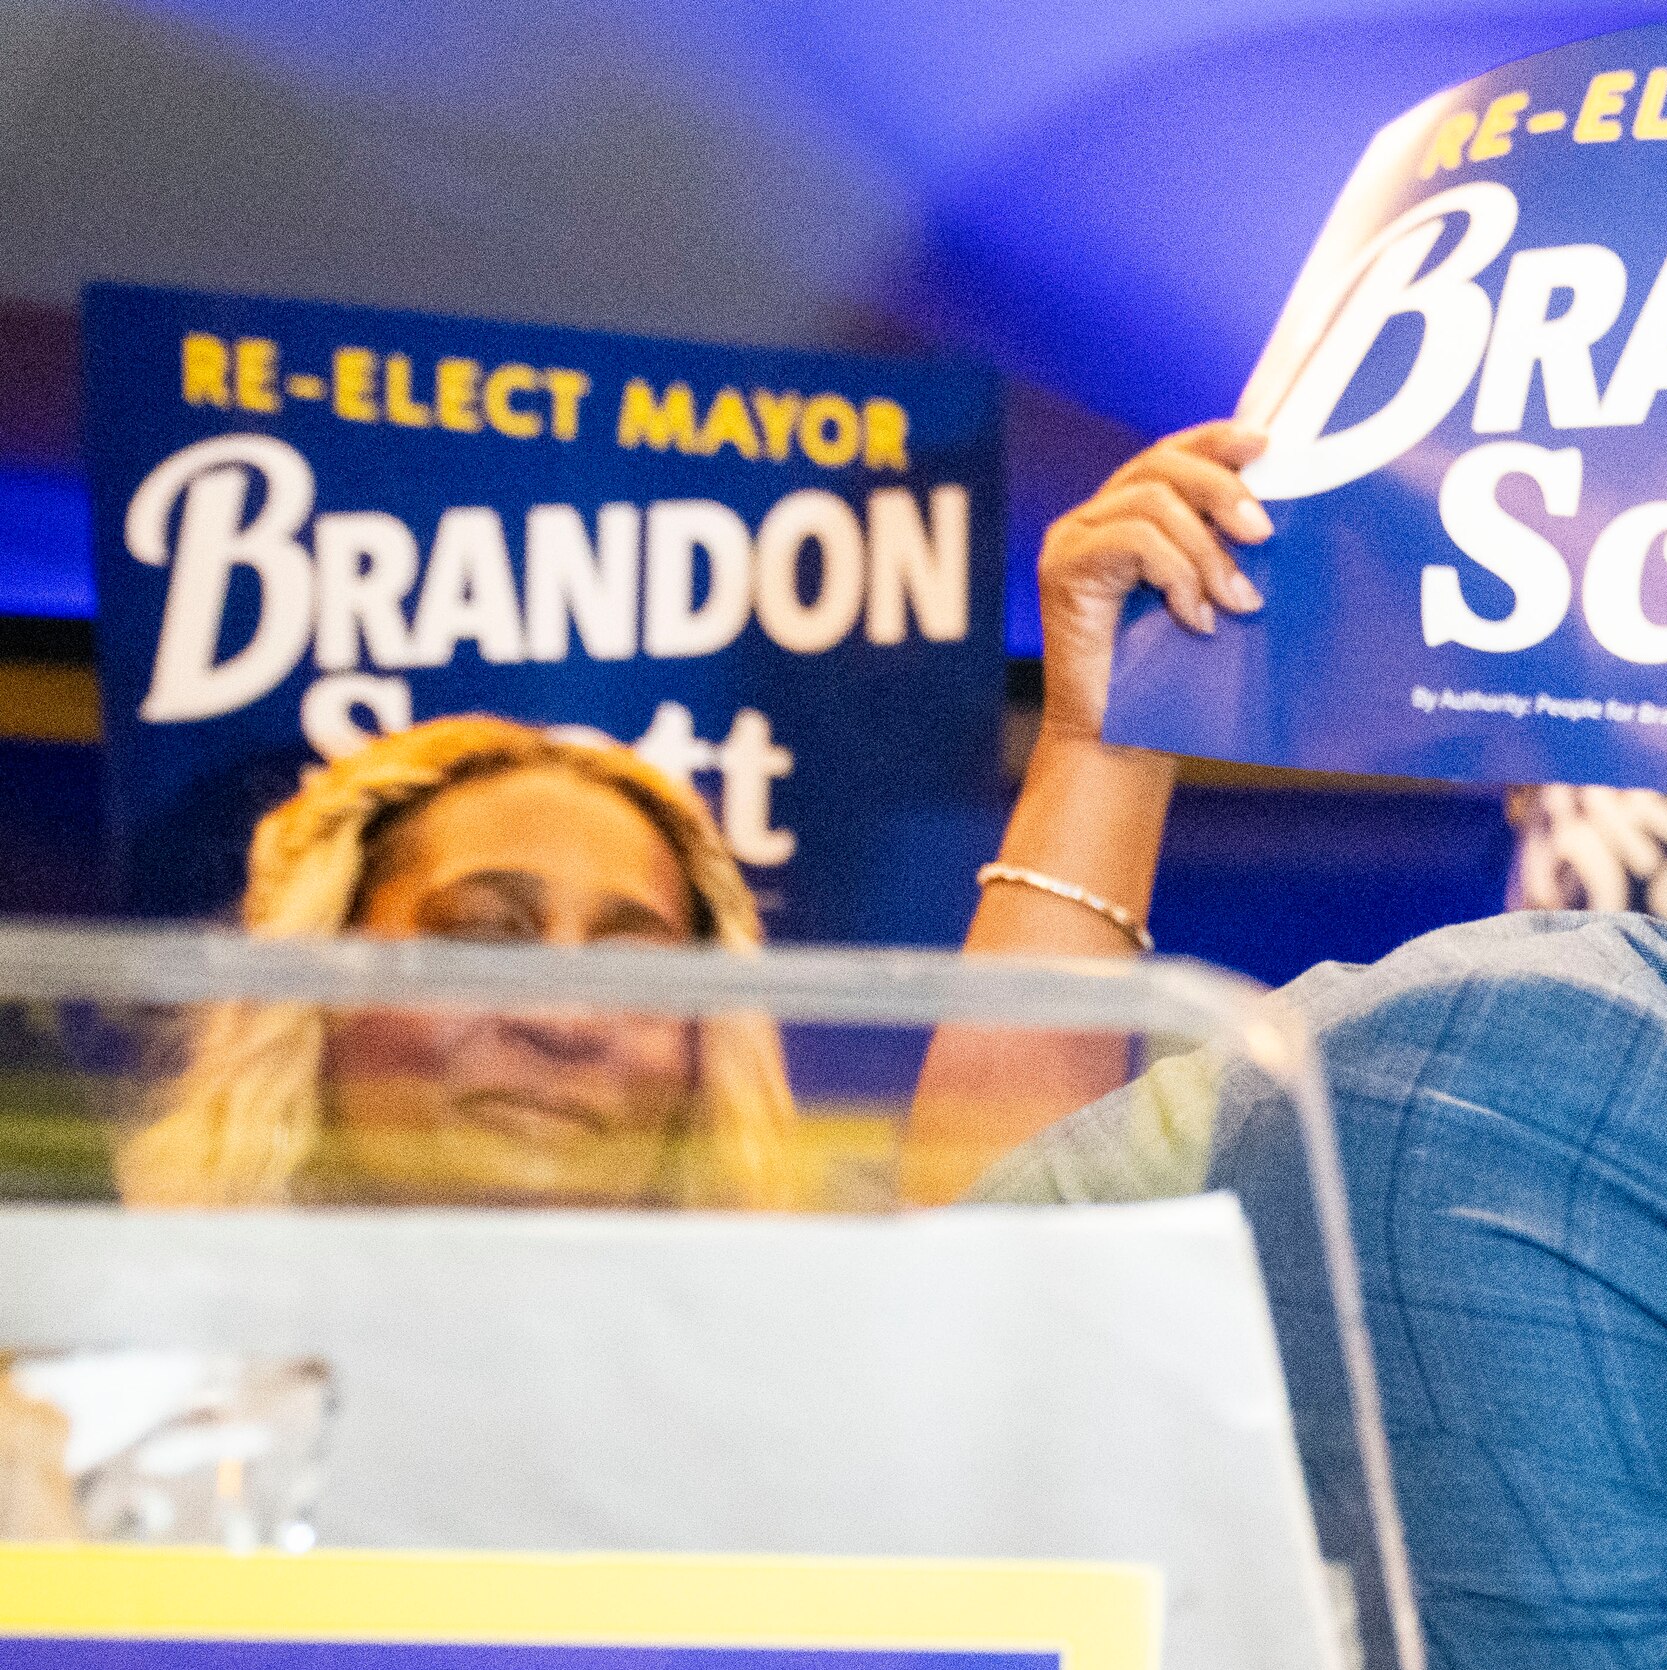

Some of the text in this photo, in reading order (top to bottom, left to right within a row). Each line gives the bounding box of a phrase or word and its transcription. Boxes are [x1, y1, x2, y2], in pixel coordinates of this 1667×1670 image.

[180, 330, 909, 472] RE-ELECT MAYOR
[123, 431, 972, 725] BRANDON
[1534, 692, 1602, 722] People
[1605, 699, 1634, 721] for
